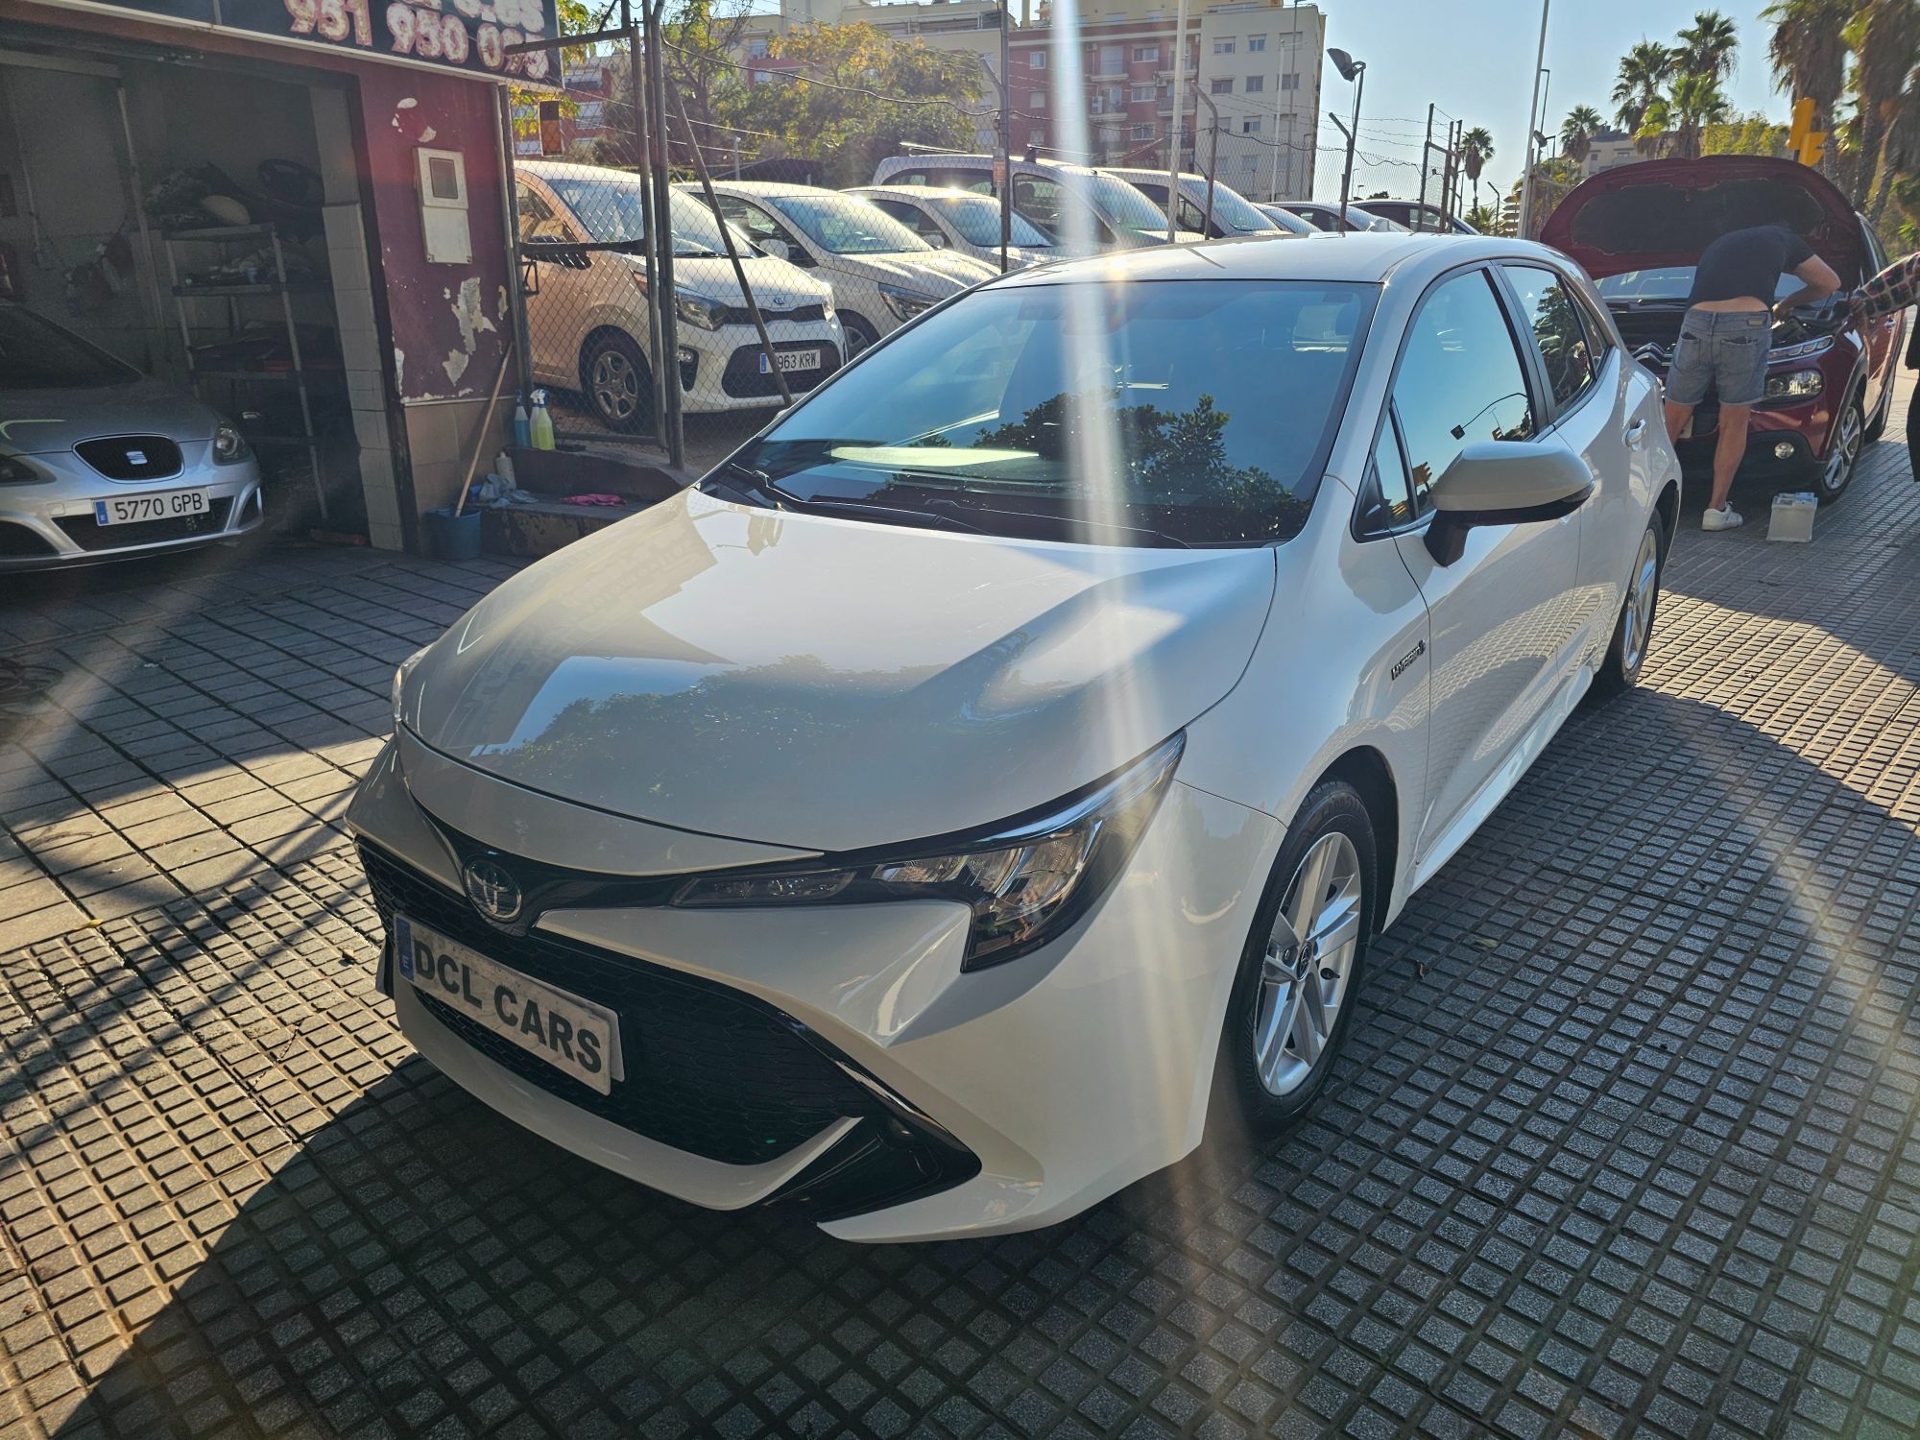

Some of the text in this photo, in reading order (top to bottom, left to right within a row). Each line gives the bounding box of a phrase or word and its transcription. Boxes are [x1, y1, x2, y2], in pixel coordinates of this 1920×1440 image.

[386, 2, 469, 64] 950
[776, 351, 817, 370] 963 KRW
[115, 492, 203, 521] 5770 GPB
[414, 940, 602, 1074] DCL CARS
